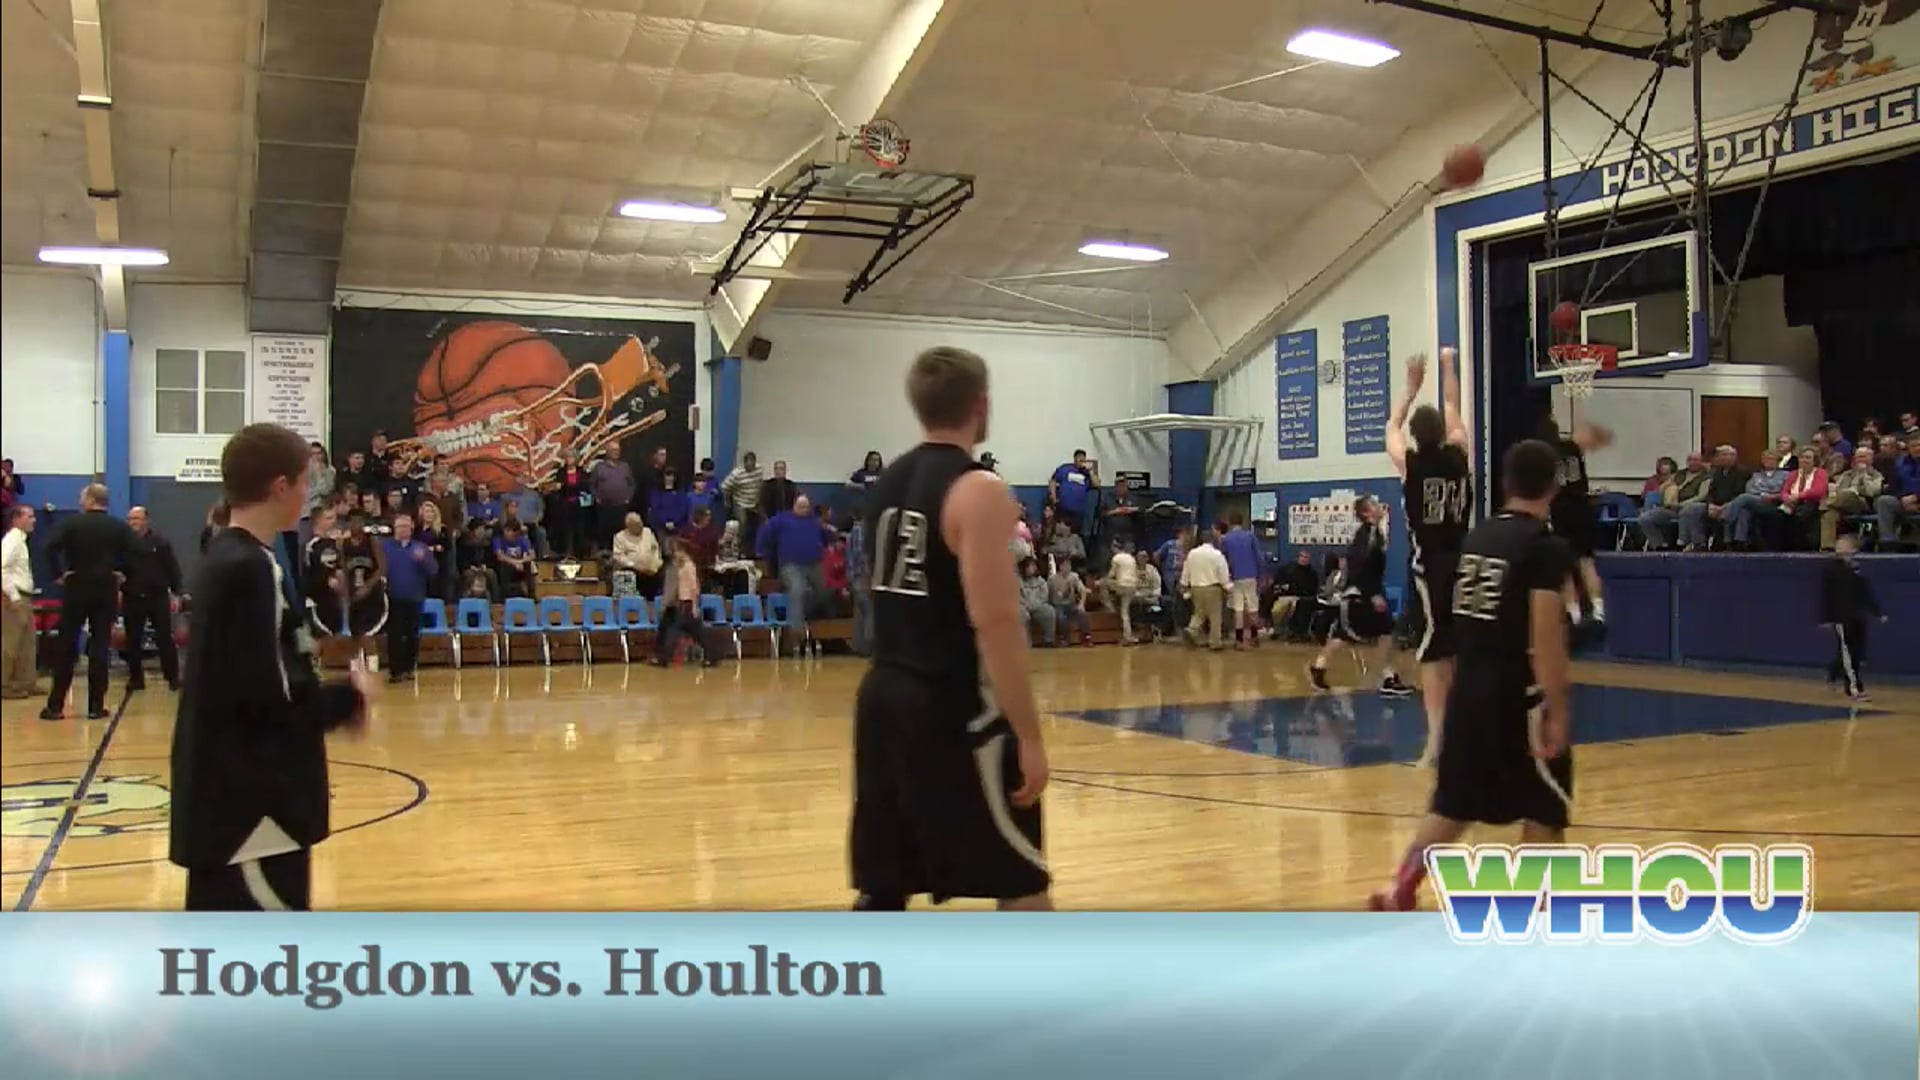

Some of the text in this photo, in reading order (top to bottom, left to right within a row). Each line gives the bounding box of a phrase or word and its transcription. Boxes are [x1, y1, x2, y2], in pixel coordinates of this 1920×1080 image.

[1602, 86, 1920, 197] HODGDON HIG
[872, 507, 928, 596] 12
[1452, 554, 1508, 620] 22
